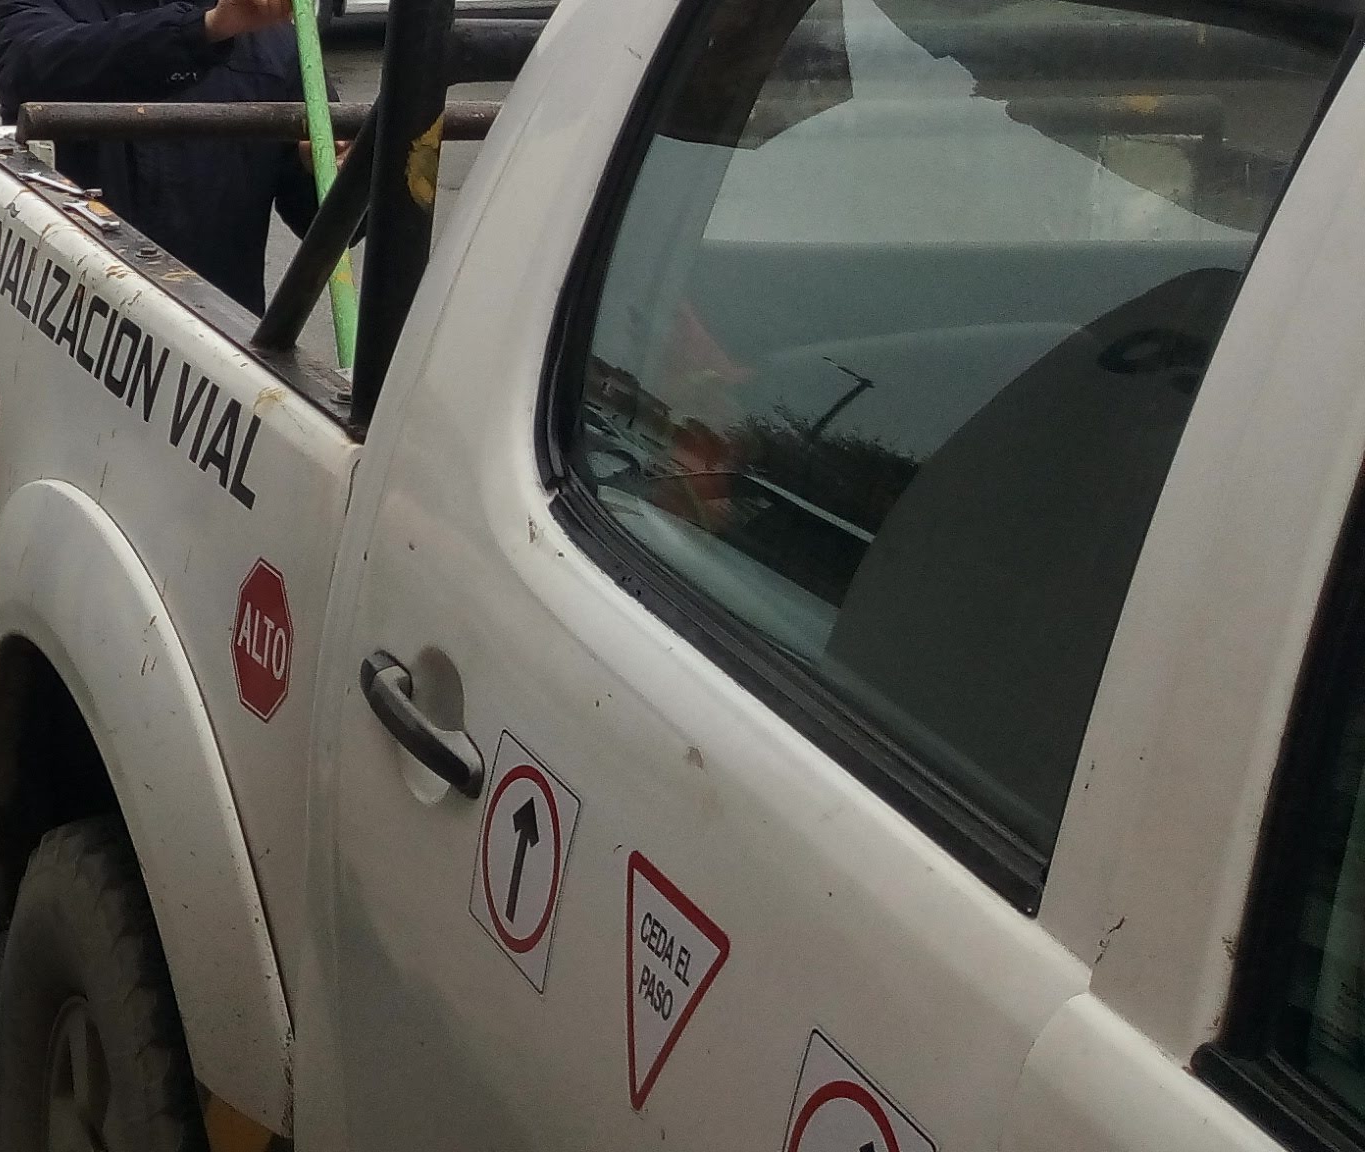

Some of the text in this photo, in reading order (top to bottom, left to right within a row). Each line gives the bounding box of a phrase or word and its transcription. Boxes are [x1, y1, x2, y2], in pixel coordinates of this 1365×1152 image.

[169, 360, 262, 511] VIAL
[237, 600, 287, 681] ALTO
[639, 912, 691, 987] CEDA EL
[638, 964, 674, 1021] PASO
